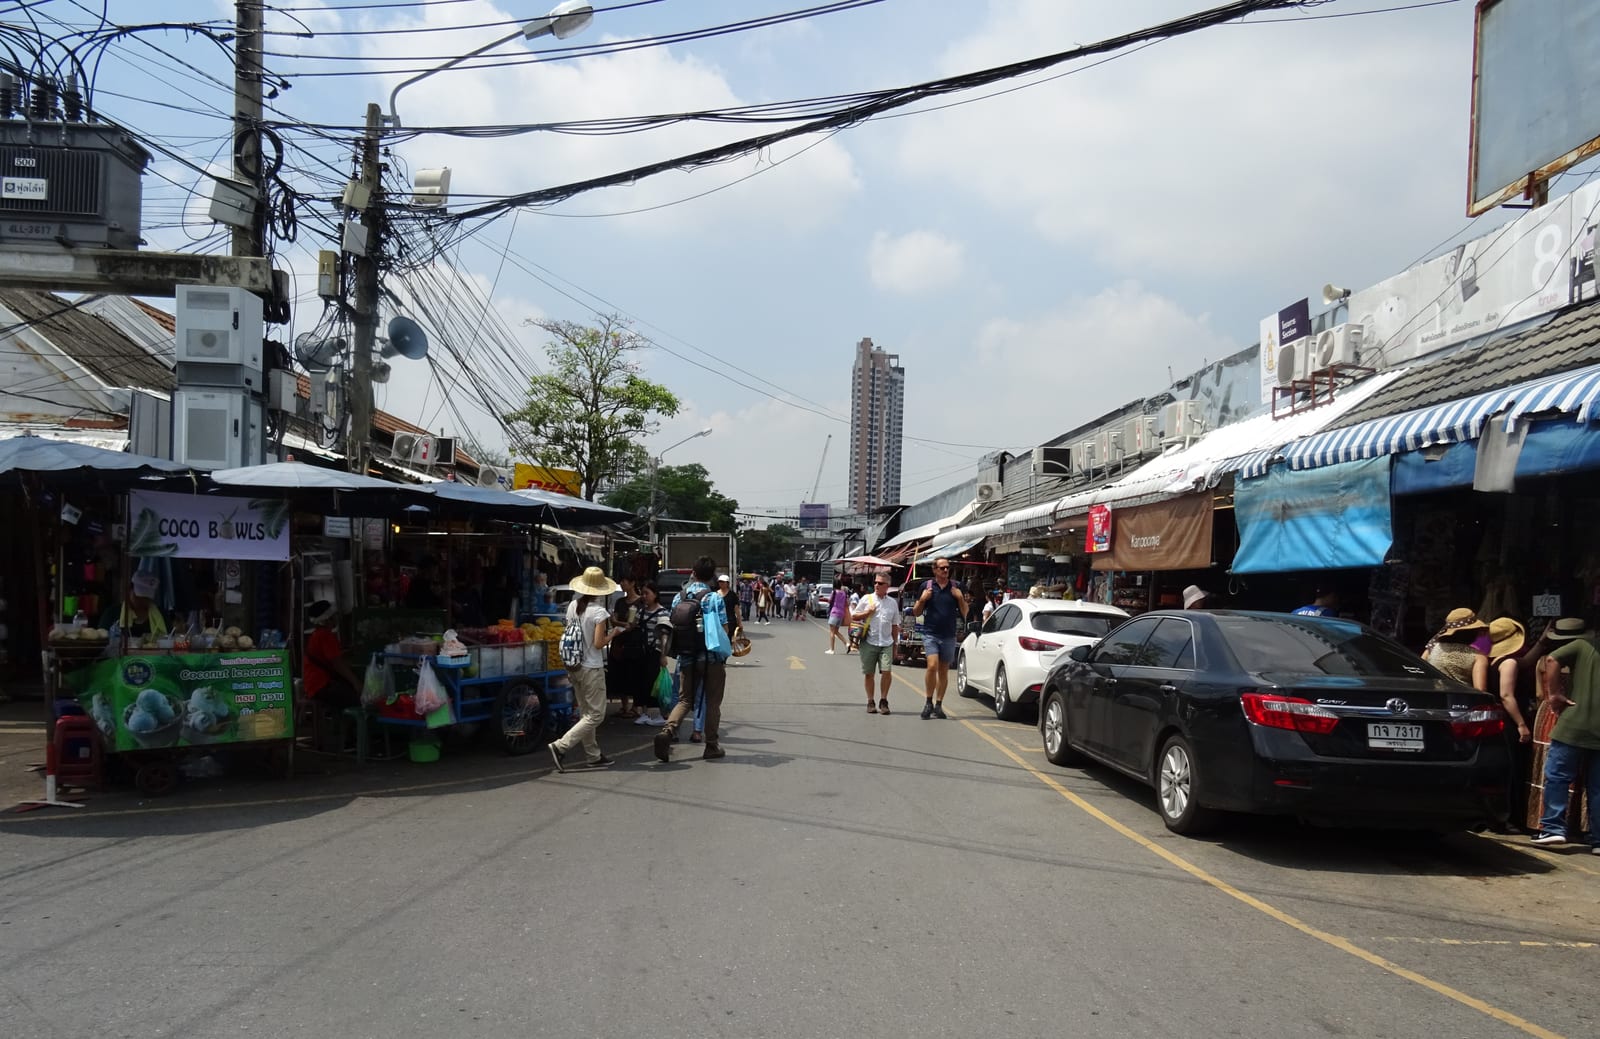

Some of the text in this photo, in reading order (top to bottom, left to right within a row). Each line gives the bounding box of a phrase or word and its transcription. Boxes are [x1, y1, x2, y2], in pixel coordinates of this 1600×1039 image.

[16, 158, 34, 167] 500
[1532, 223, 1563, 291] 8
[1281, 328, 1297, 340] Section
[159, 518, 200, 538] COCO
[180, 667, 283, 681] Coconut Icecream
[1373, 725, 1421, 738] กจ 7317
